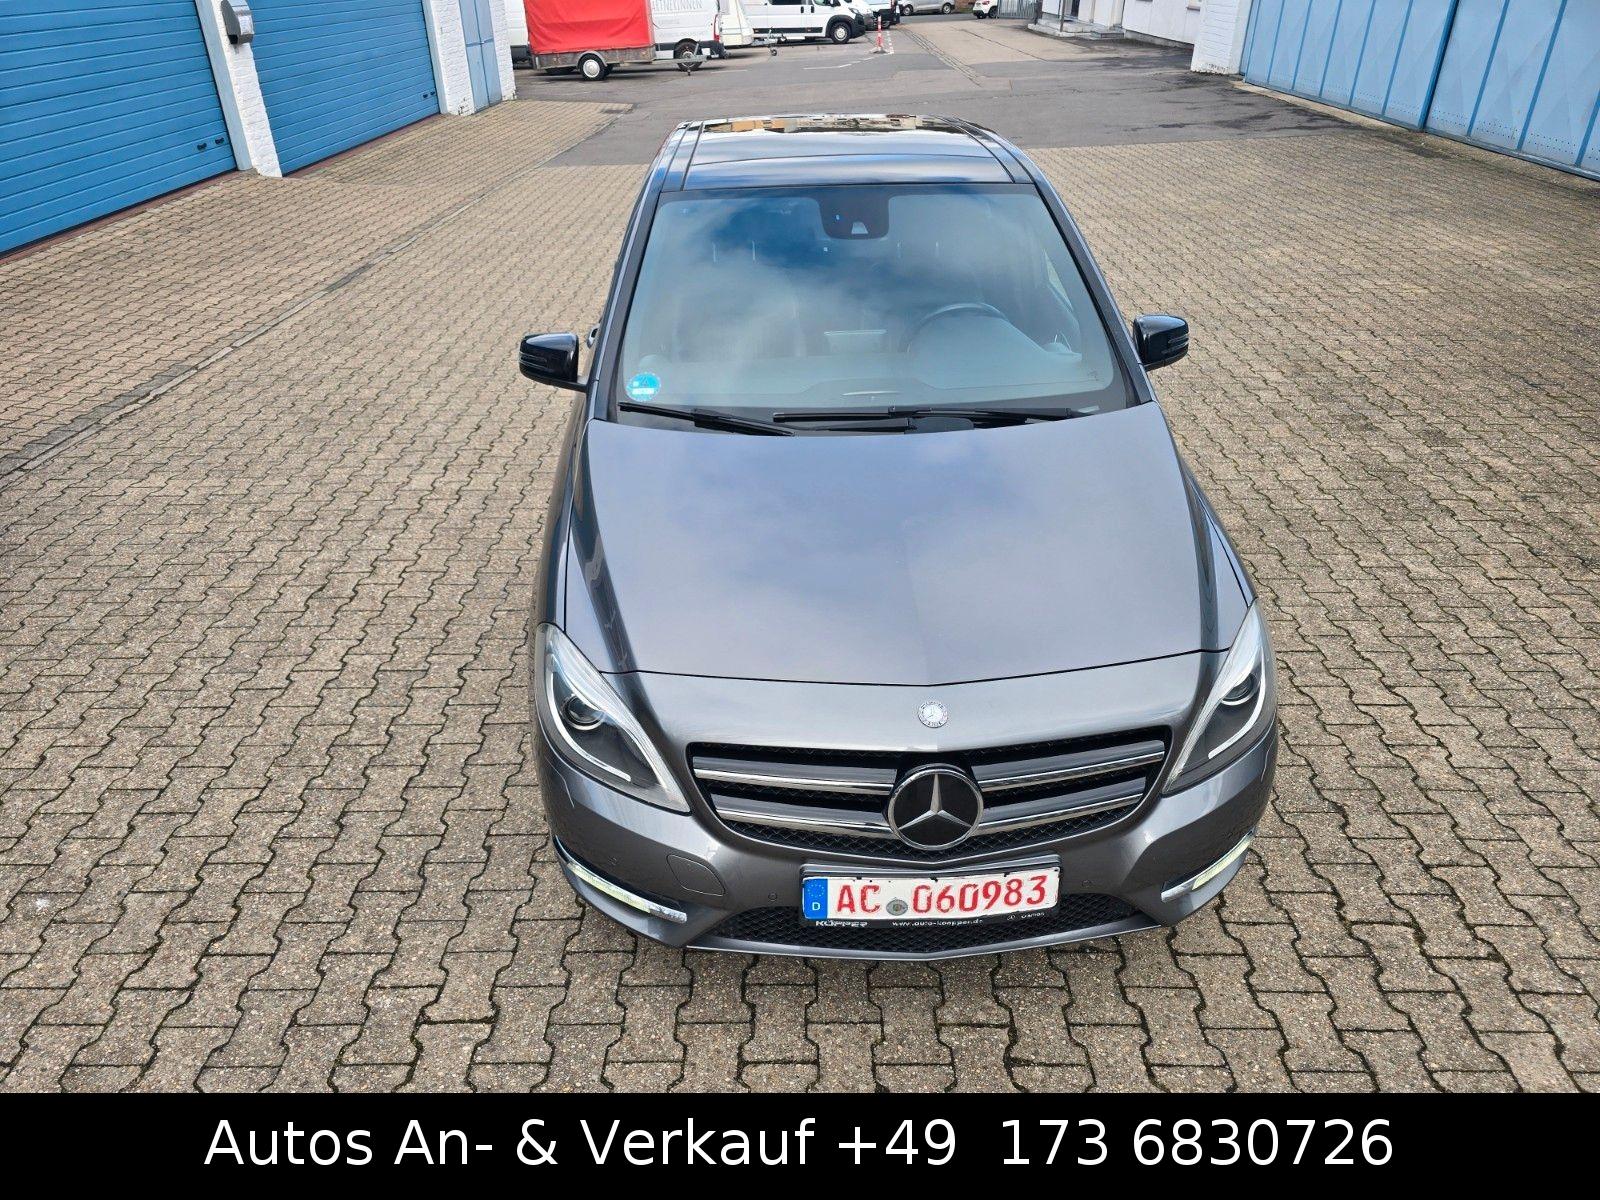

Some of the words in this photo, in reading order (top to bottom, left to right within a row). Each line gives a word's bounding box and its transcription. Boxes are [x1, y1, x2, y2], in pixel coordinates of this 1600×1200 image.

[811, 902, 821, 911] D
[836, 884, 881, 914] AC
[912, 875, 1048, 914] 060983
